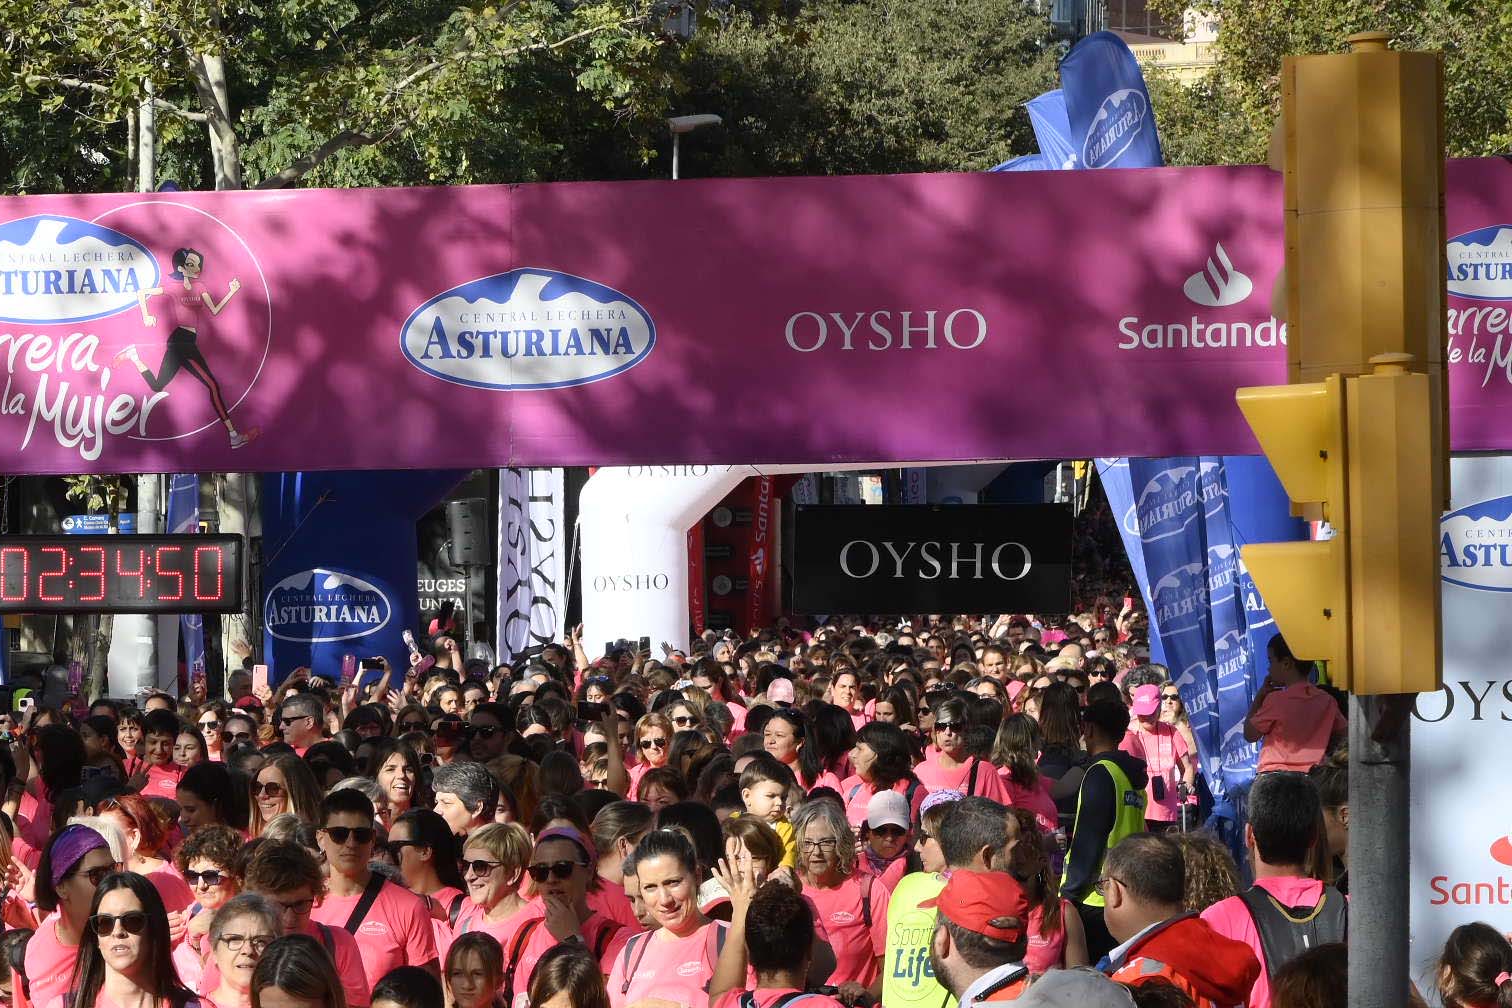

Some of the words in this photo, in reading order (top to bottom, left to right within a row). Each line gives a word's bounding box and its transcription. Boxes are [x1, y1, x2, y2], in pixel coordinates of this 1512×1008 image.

[63, 250, 136, 263] LECHERA
[1459, 250, 1510, 259] CENTRAL
[459, 309, 538, 324] CENTRAL
[548, 308, 627, 322] LECHERA
[785, 307, 988, 353] OYSHO
[1447, 306, 1512, 336] arre
[420, 314, 636, 361] ASTURIANA
[1468, 336, 1486, 364] la
[0, 377, 25, 416] la
[21, 365, 170, 462] Mujer
[755, 477, 770, 542] Santa
[0, 545, 223, 602] 02:34:50
[505, 467, 531, 662] OYSH
[839, 539, 1033, 582] OYSHO
[593, 573, 669, 592] OYSHO
[267, 597, 383, 627] ASTURIANA
[418, 597, 466, 611] UNA
[891, 921, 935, 949] Sport
[892, 946, 937, 987] Life
